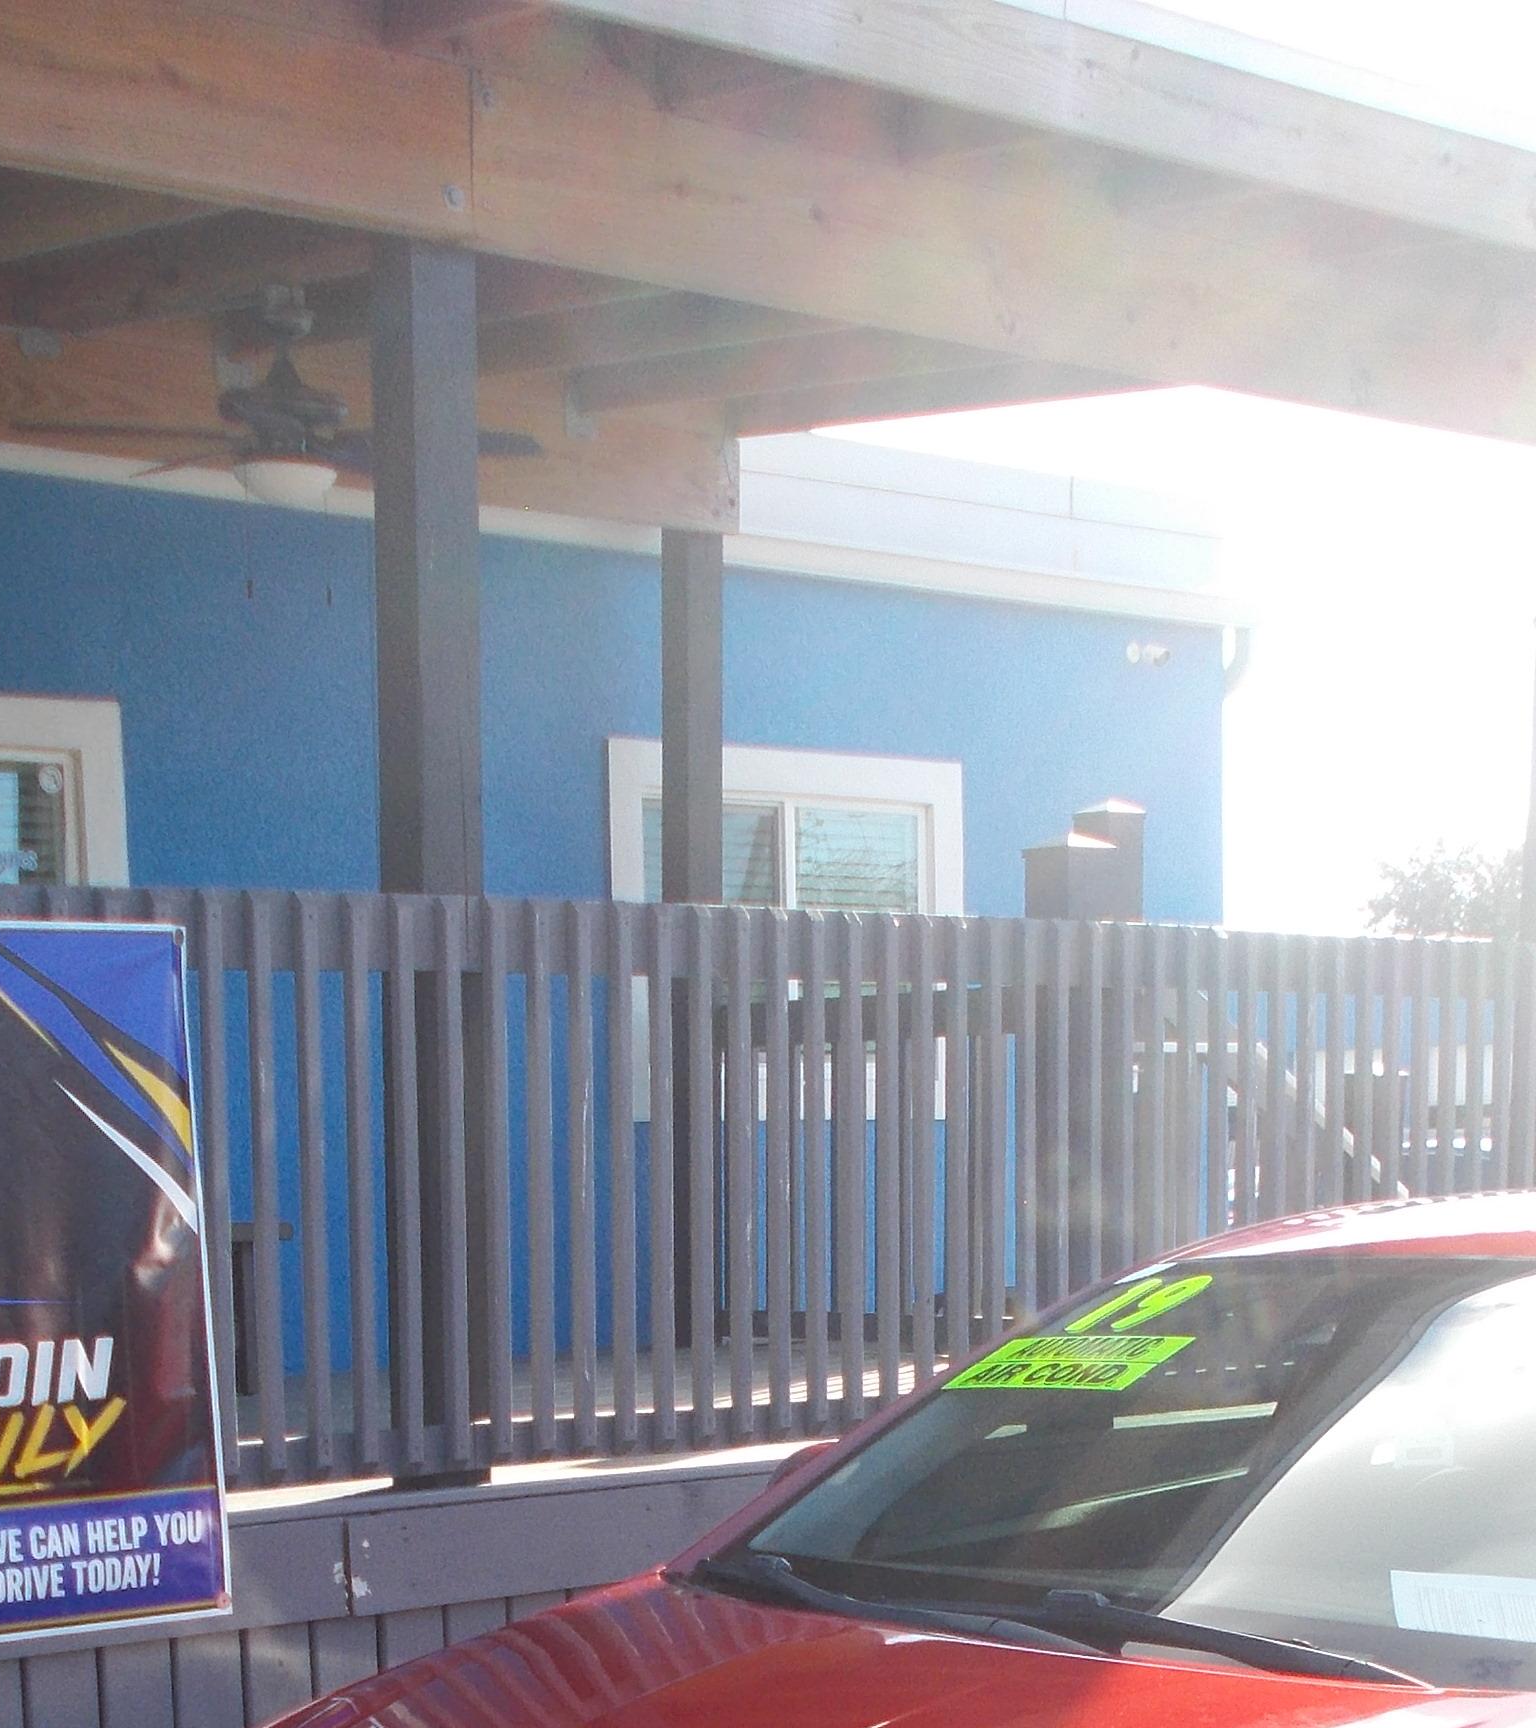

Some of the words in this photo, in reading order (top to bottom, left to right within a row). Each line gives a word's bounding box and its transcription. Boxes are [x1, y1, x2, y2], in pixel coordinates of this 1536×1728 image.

[1065, 1275, 1213, 1333] 19
[1008, 1337, 1165, 1360] AUTOMATIC
[961, 1363, 1032, 1386] AIR
[28, 1520, 81, 1561] CAN
[86, 1514, 149, 1555] HELP
[153, 1509, 203, 1547] YOU
[71, 1552, 162, 1597] TODAY!
